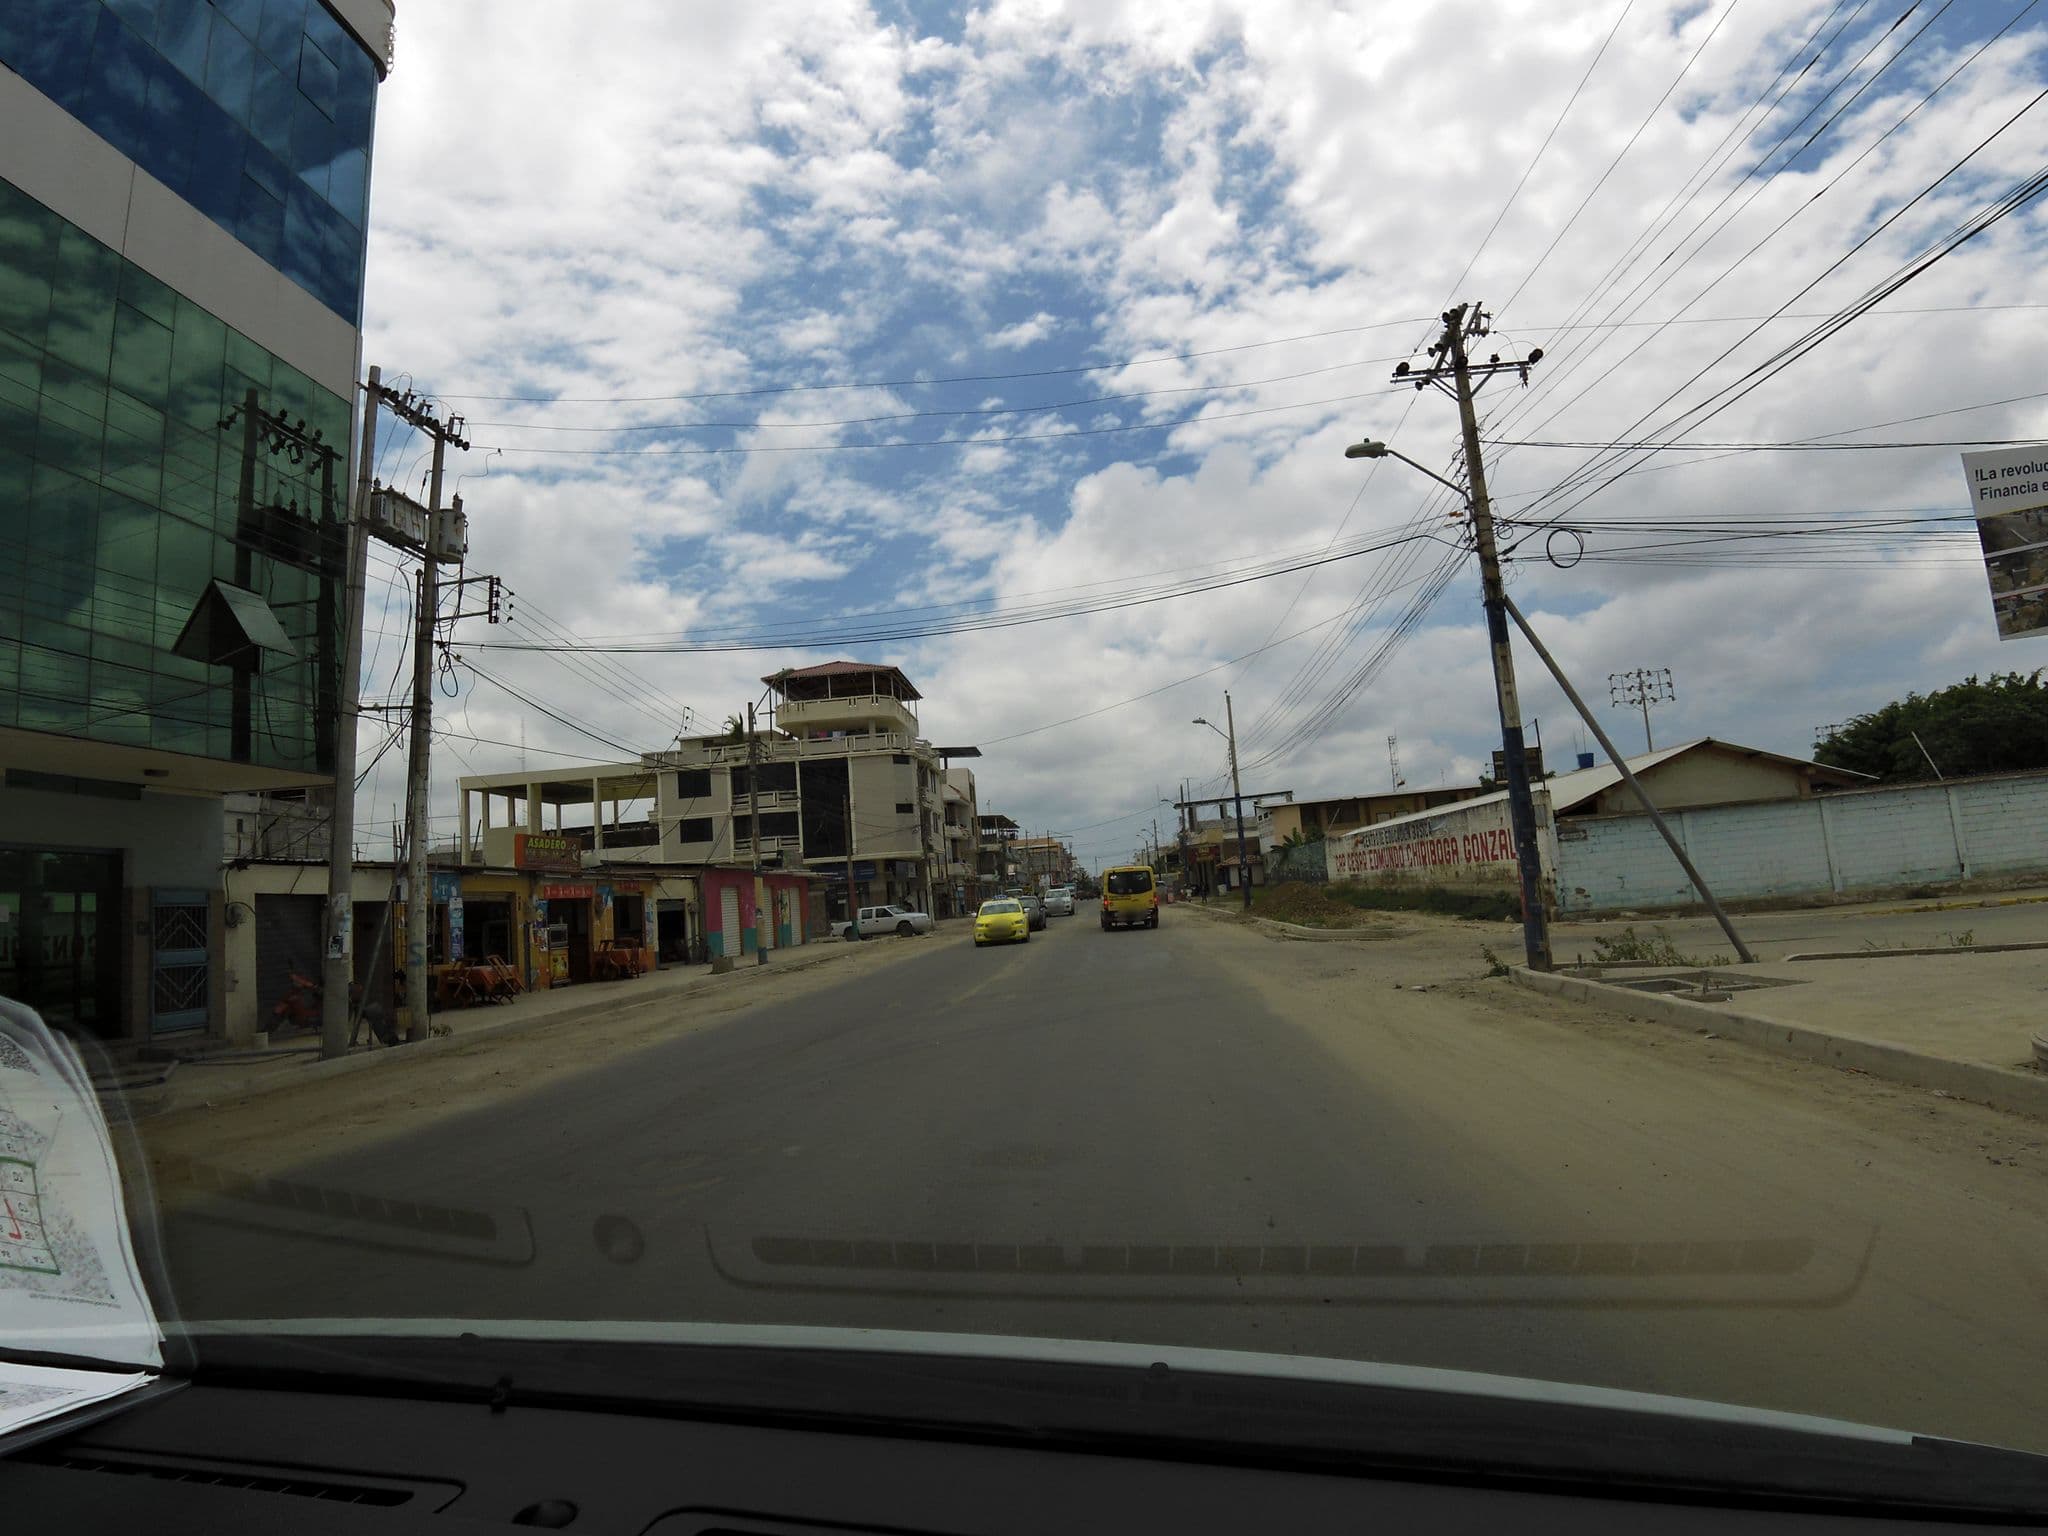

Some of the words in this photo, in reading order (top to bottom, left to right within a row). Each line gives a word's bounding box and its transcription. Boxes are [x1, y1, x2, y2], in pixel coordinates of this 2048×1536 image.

[1980, 481, 2038, 501] Financia
[527, 838, 567, 850] ASADERO
[1368, 844, 1404, 870] EDMUNDO
[1406, 836, 1459, 867] CHIRIBOGA
